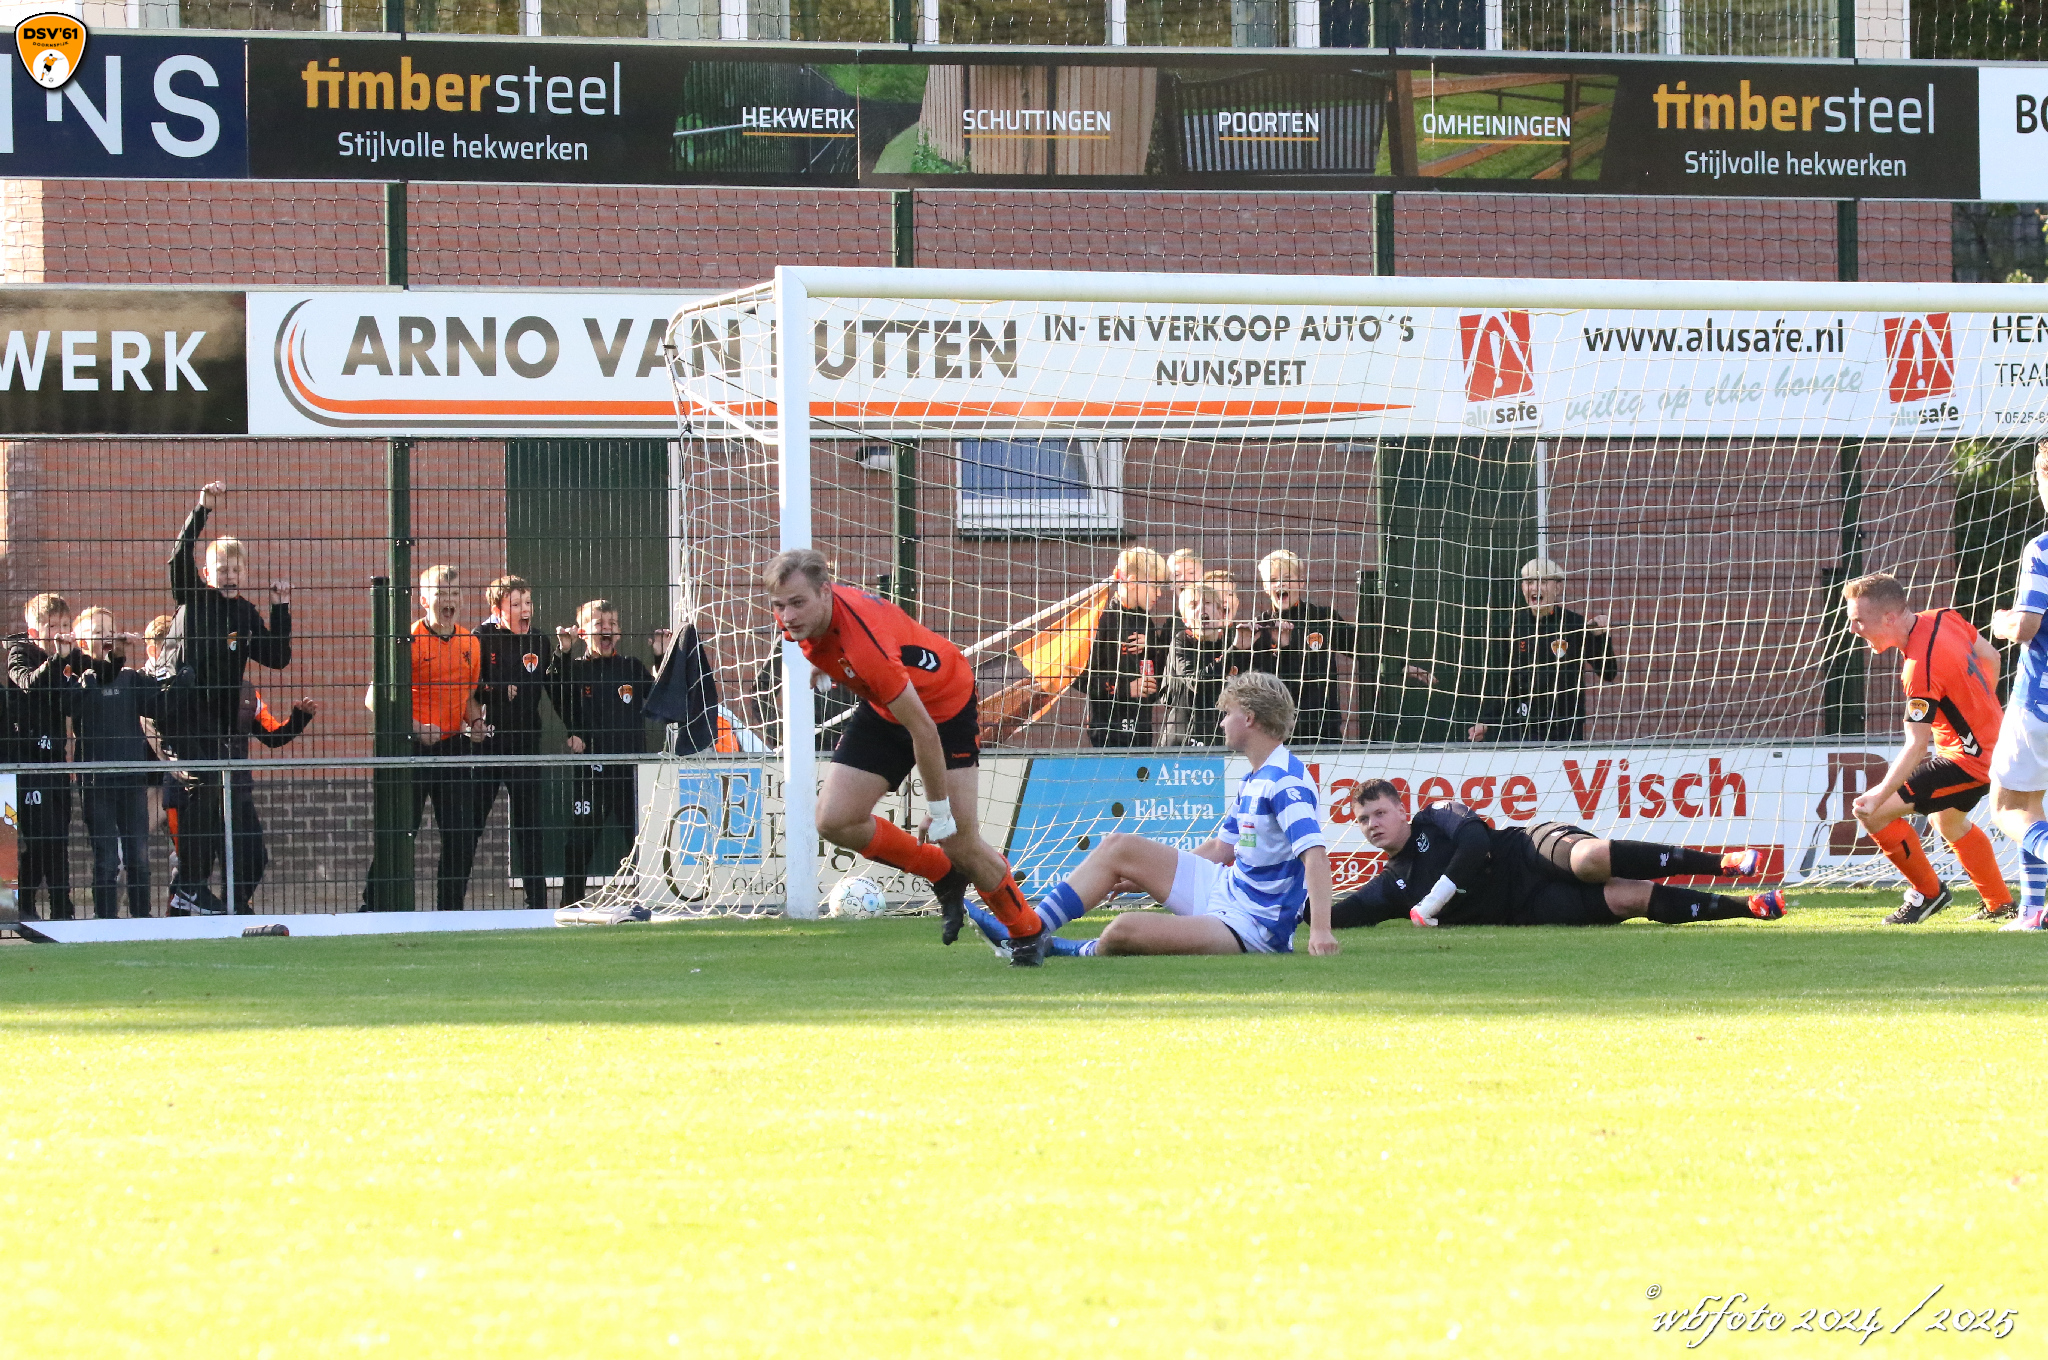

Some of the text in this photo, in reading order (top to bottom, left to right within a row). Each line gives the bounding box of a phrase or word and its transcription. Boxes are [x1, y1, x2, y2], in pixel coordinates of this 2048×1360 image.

[301, 56, 621, 116] timbersteel
[742, 106, 855, 130] HEKWERK
[962, 108, 1111, 132] SCHUTTINGEN
[1653, 80, 1935, 134] timbersteel
[1218, 111, 1320, 134] POORTEN
[1422, 113, 1572, 138] OMHEININGEN
[338, 131, 588, 163] Stijlvolle hekwerken
[1685, 150, 1907, 179] Stijlvolle hekwerken
[1044, 315, 1086, 341] IN-
[1098, 315, 1136, 341] EN
[1145, 315, 1291, 342] VERKOOP
[1583, 318, 1844, 353] www.alusafe.nl
[341, 315, 1018, 381] ARNO VAN UTTEN
[1156, 360, 1307, 387] NUNSPEET
[1994, 363, 2048, 387] TRA
[1565, 365, 1863, 426] veilig op elke hoogte
[1466, 401, 1538, 427] alusafe
[1889, 402, 1959, 427] alusafe
[1155, 763, 1215, 786] Airco
[1306, 763, 1538, 830] anege
[1563, 758, 1746, 819] Visch
[574, 801, 591, 815] 36
[1133, 798, 1215, 821] Elektra
